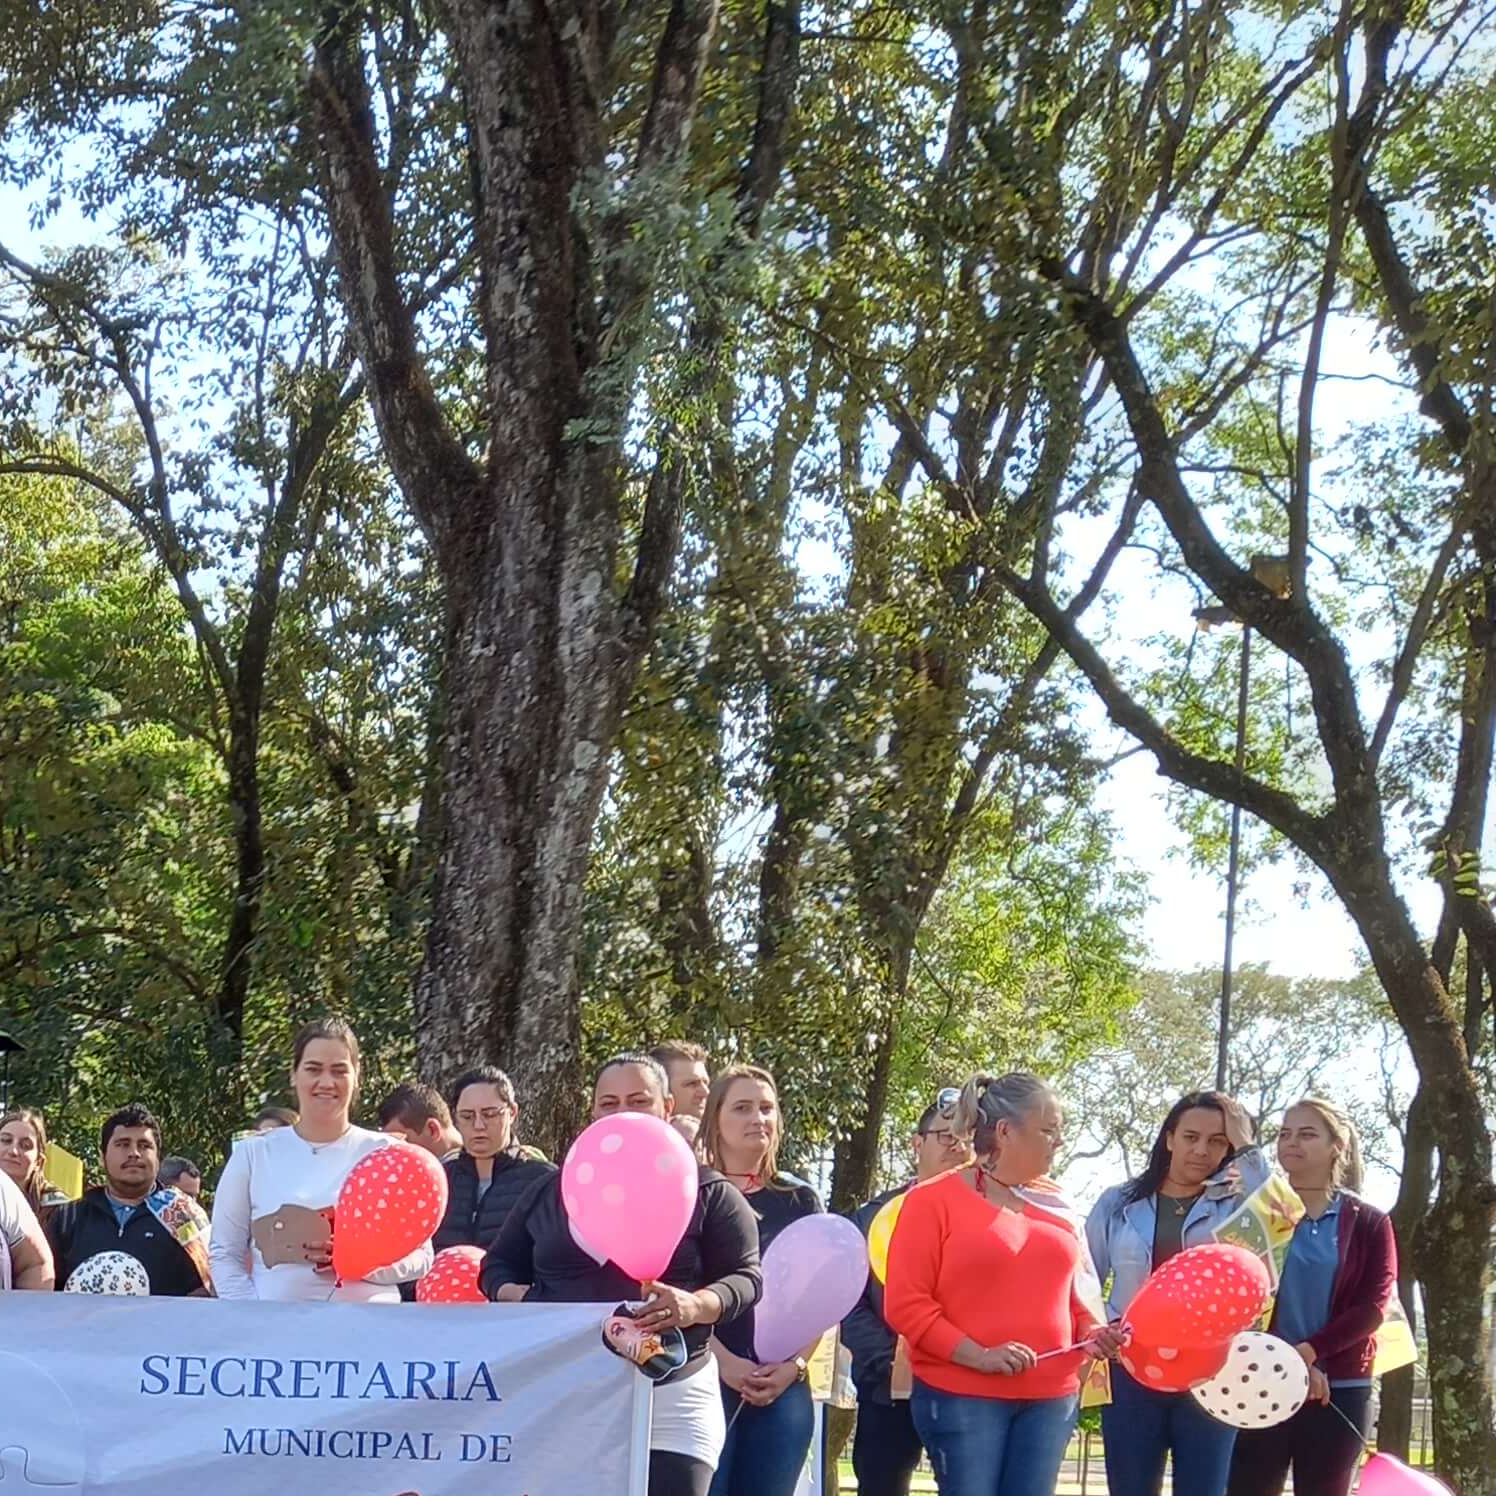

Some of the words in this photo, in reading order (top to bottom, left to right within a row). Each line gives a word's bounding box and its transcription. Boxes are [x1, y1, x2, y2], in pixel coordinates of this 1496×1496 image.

[140, 1354, 503, 1403] SECRETARIA
[222, 1428, 442, 1461] MUNICIPAL
[459, 1434, 513, 1464] DE
